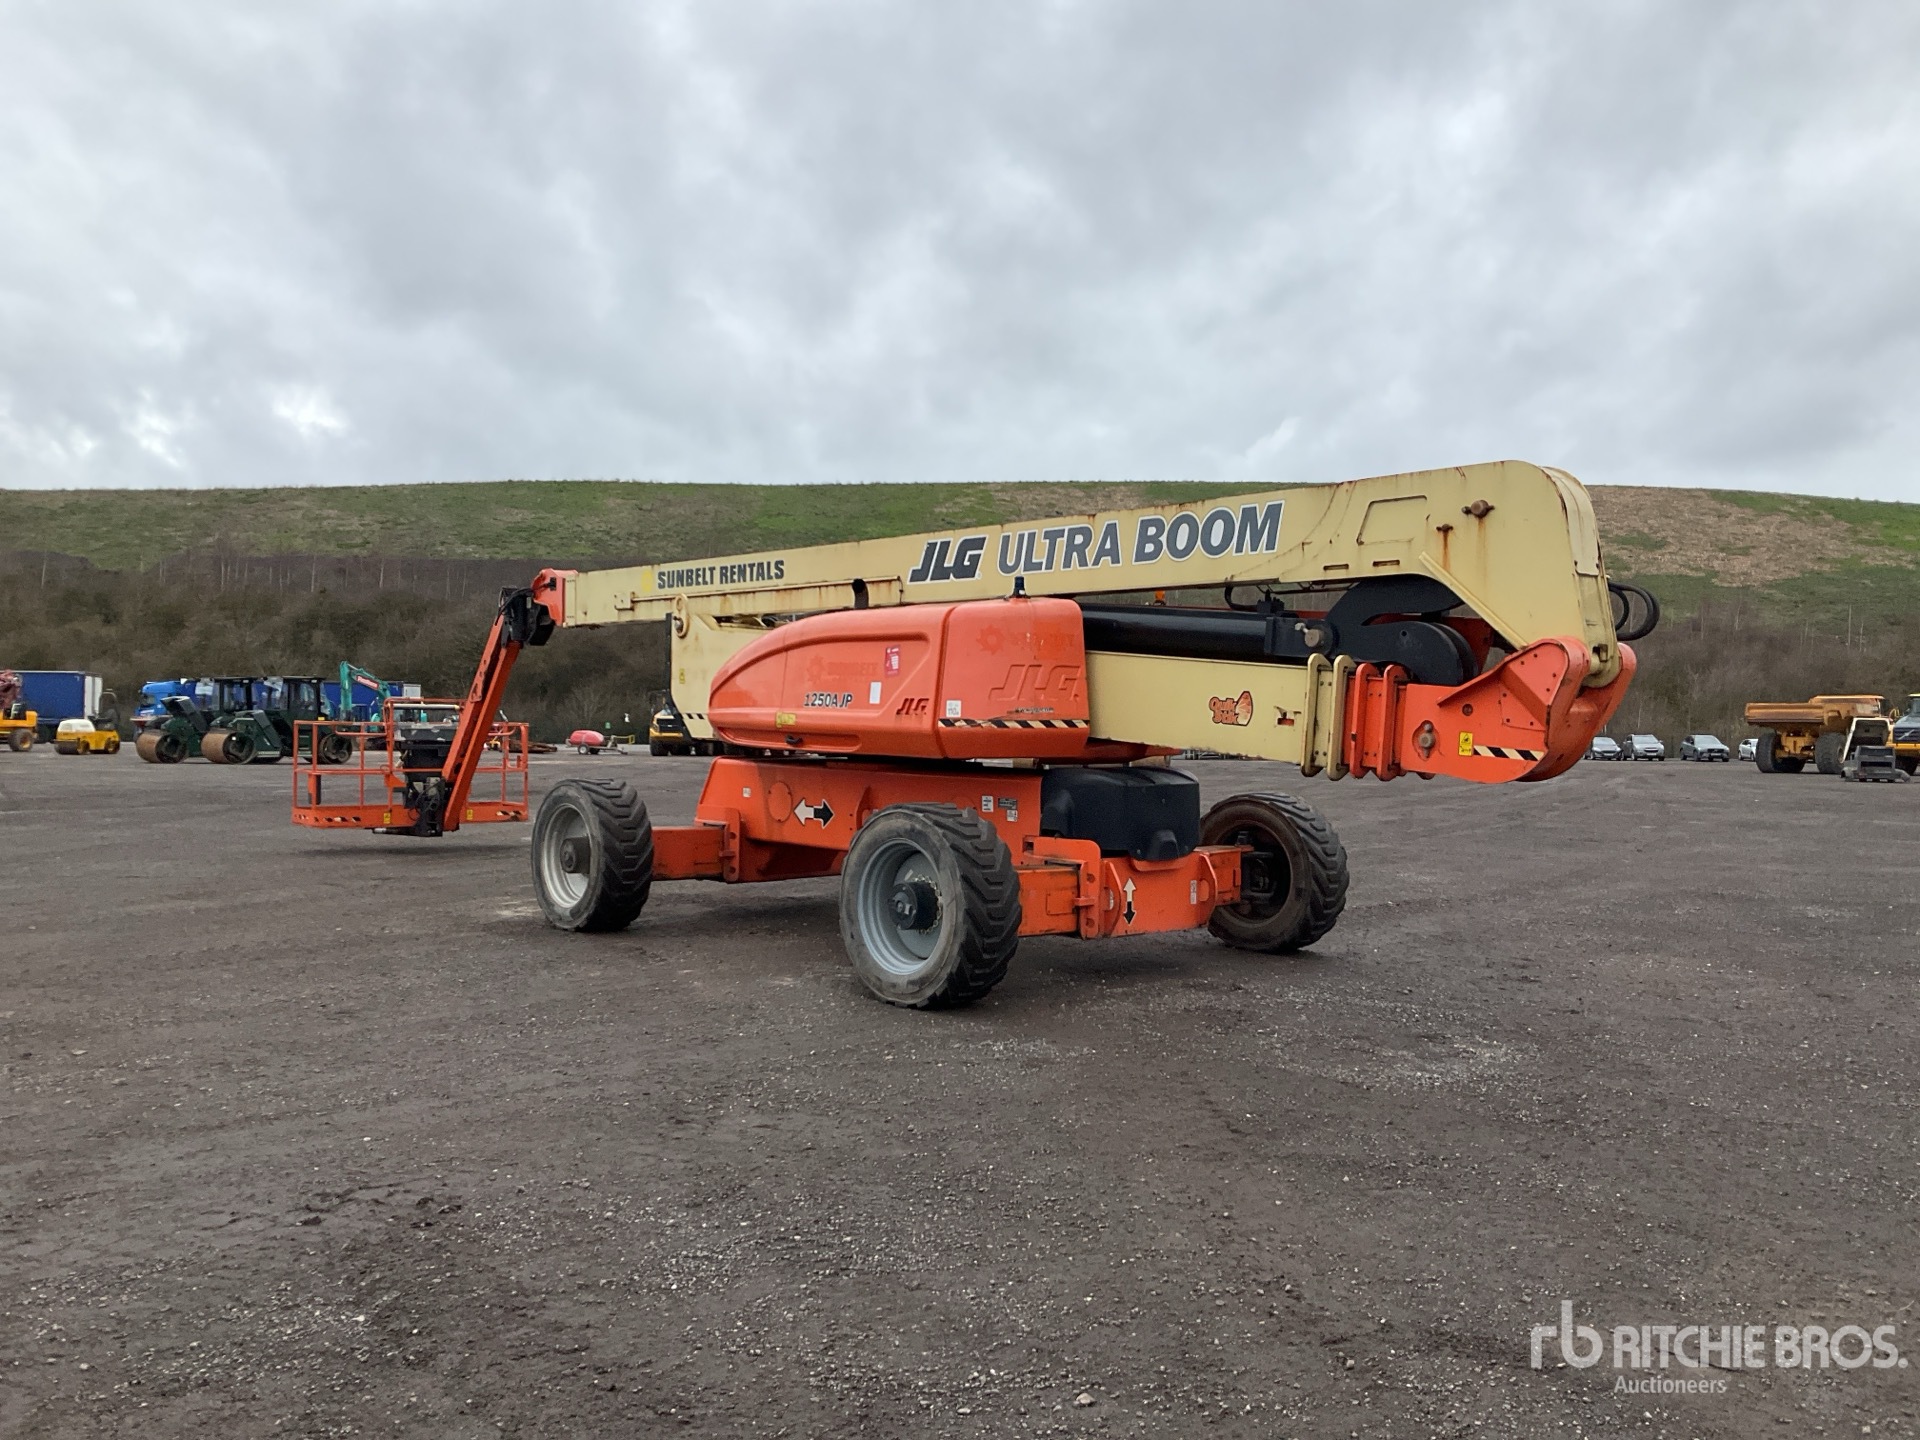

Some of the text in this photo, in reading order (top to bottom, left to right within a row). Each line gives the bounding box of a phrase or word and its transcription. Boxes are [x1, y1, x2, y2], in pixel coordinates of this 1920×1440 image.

[907, 500, 1285, 584] JLG ULTRA BOOM
[657, 559, 785, 589] SUNBELT RENTALS
[988, 664, 1081, 701] JLG
